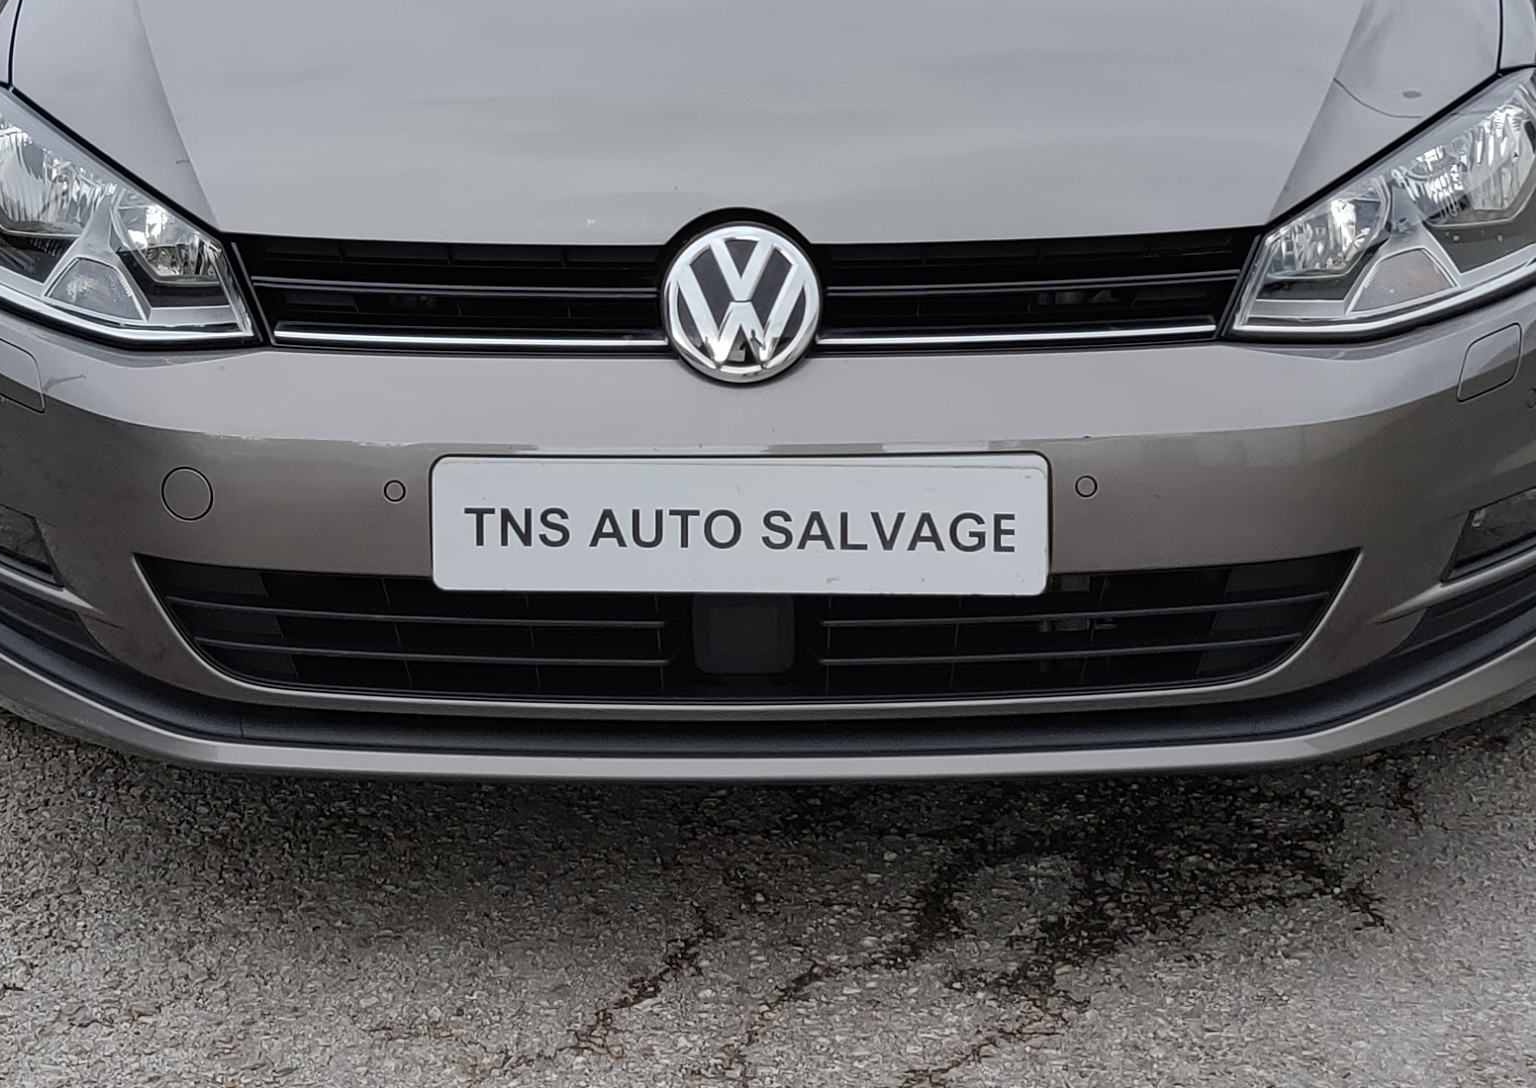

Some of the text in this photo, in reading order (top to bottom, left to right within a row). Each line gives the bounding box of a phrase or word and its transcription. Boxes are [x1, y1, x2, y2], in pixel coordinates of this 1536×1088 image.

[464, 507, 1017, 553] TNS AUTO SALVAGE
